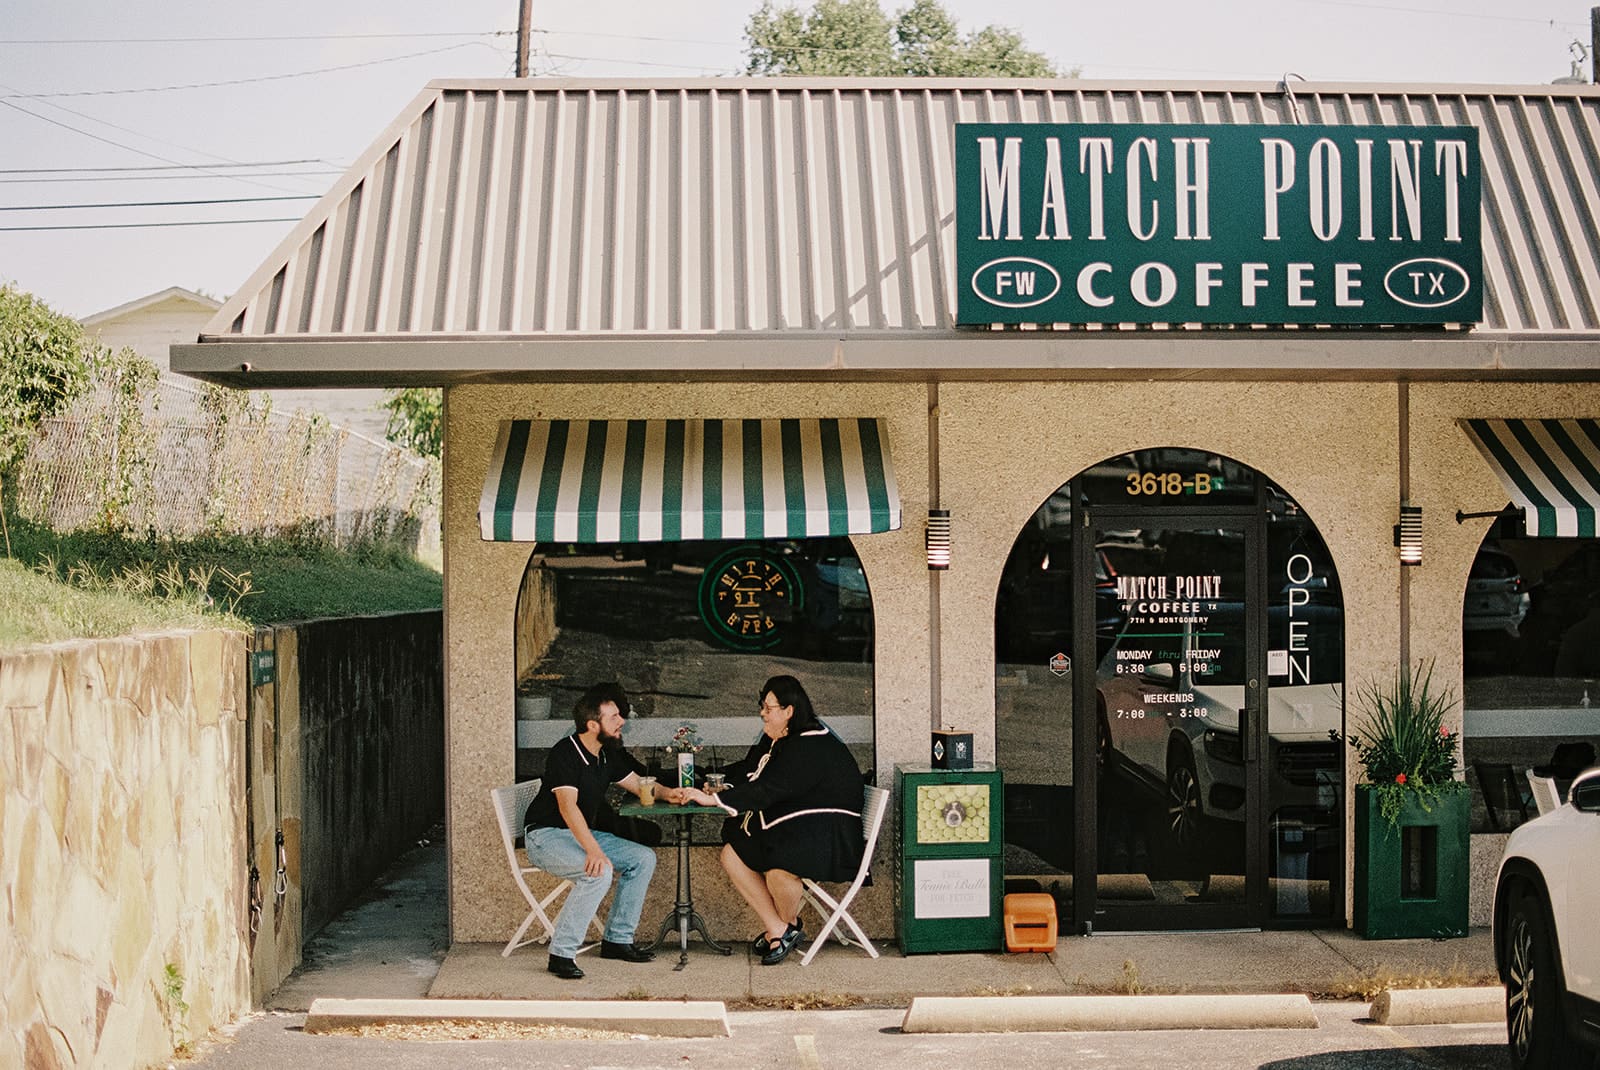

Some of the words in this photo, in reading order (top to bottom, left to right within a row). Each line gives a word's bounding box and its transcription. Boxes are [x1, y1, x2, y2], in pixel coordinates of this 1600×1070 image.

[977, 137, 1210, 241] MATCH
[1260, 138, 1467, 242] POINT
[996, 271, 1036, 296] FW
[1077, 261, 1364, 307] COFFEE
[1408, 272, 1445, 296] TX
[1126, 472, 1211, 495] 3618-B
[1117, 576, 1167, 600] MATCH
[1175, 575, 1221, 599] POINT
[1138, 602, 1201, 613] COFFEE
[1207, 603, 1217, 611] TX
[1158, 616, 1209, 624] MONTGOMERY
[1286, 554, 1313, 685] OPEN
[1116, 650, 1153, 660] MONDAY
[1158, 649, 1181, 659] thru
[1185, 649, 1221, 659] FRIDAY
[1116, 664, 1145, 674] 6:30
[1179, 662, 1208, 673] 5:00
[1143, 693, 1195, 704] WEEKENDS
[1117, 709, 1145, 719] 7:00
[1179, 708, 1208, 718] 3:00
